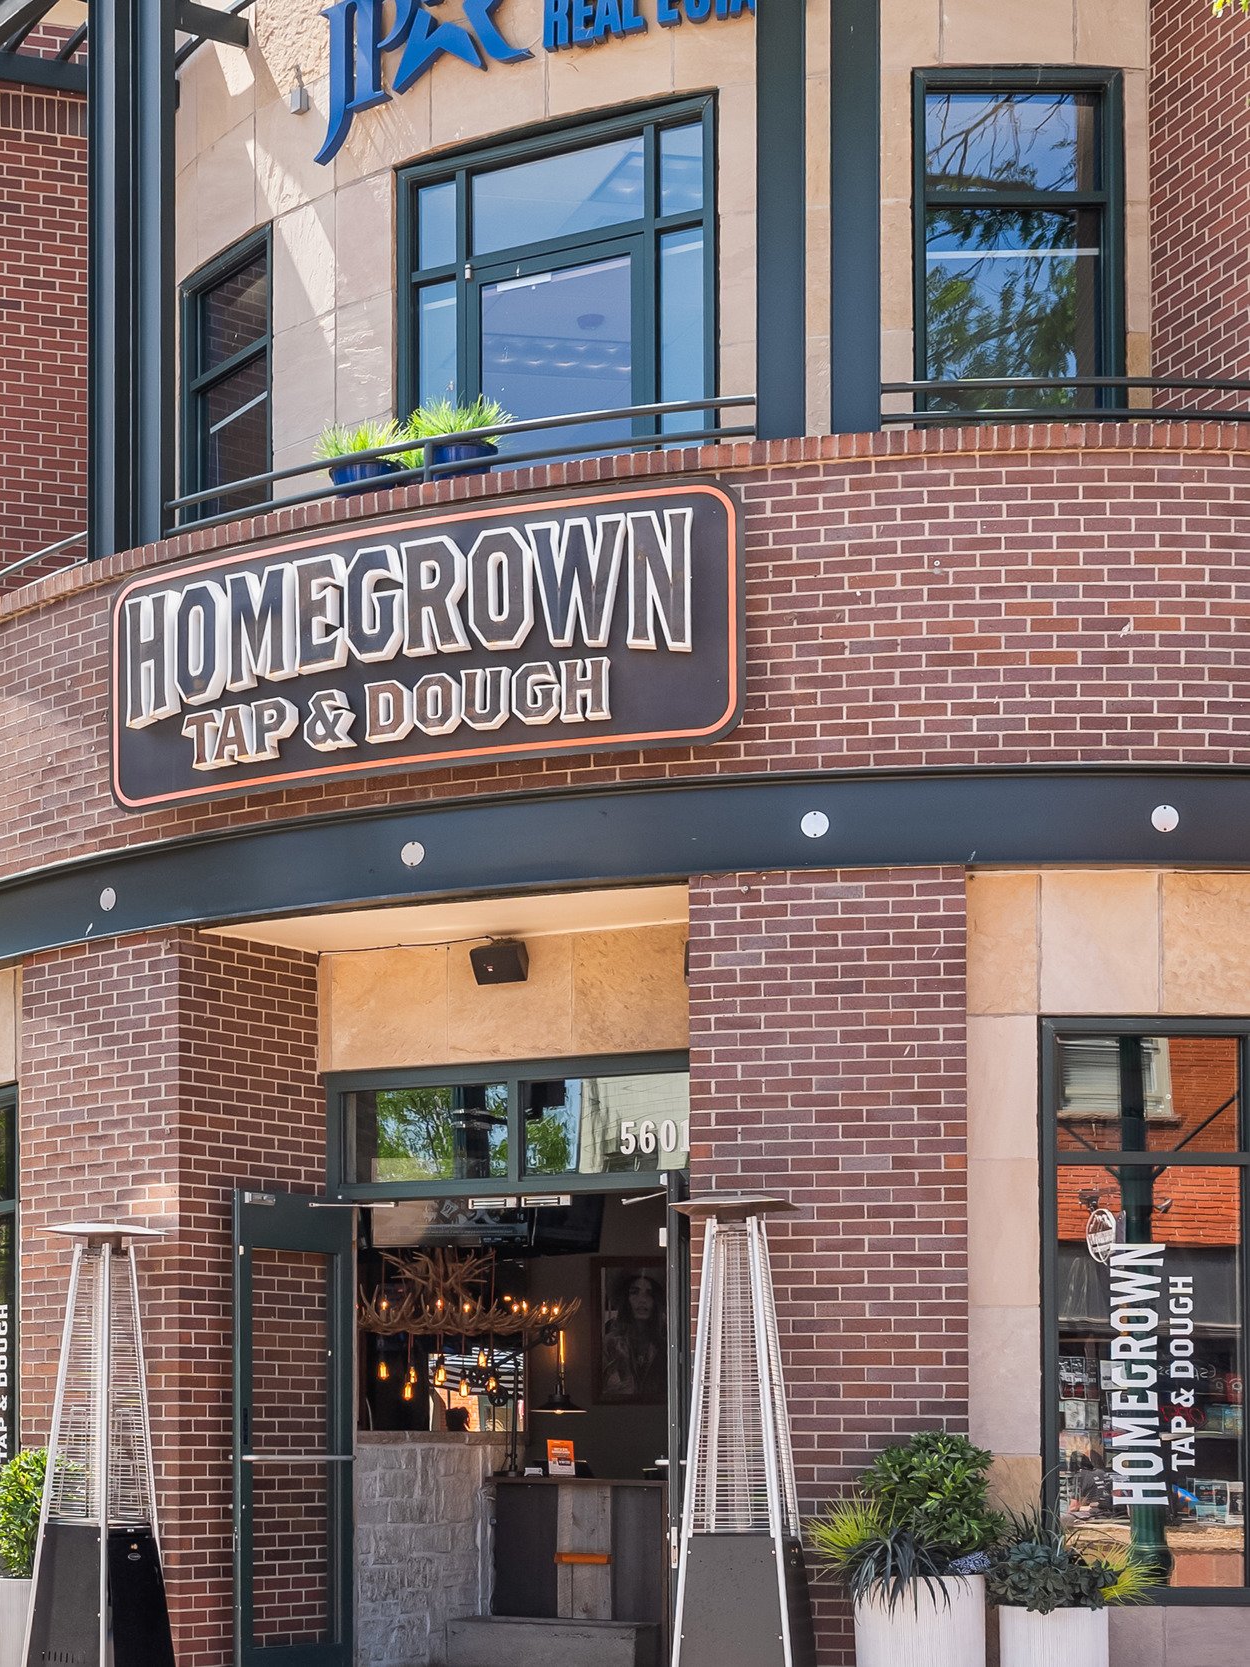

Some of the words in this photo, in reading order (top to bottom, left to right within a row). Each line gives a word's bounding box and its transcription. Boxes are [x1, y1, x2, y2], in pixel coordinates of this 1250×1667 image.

[124, 506, 695, 731] HOMEGROWN
[181, 697, 300, 772] TAP
[302, 689, 357, 753] &
[364, 656, 612, 744] DOUGH
[1109, 1243, 1169, 1506] HOMEGROWN
[1169, 1275, 1195, 1379] DOUGH
[1170, 1387, 1195, 1407] &
[1170, 1416, 1196, 1472] TAP
